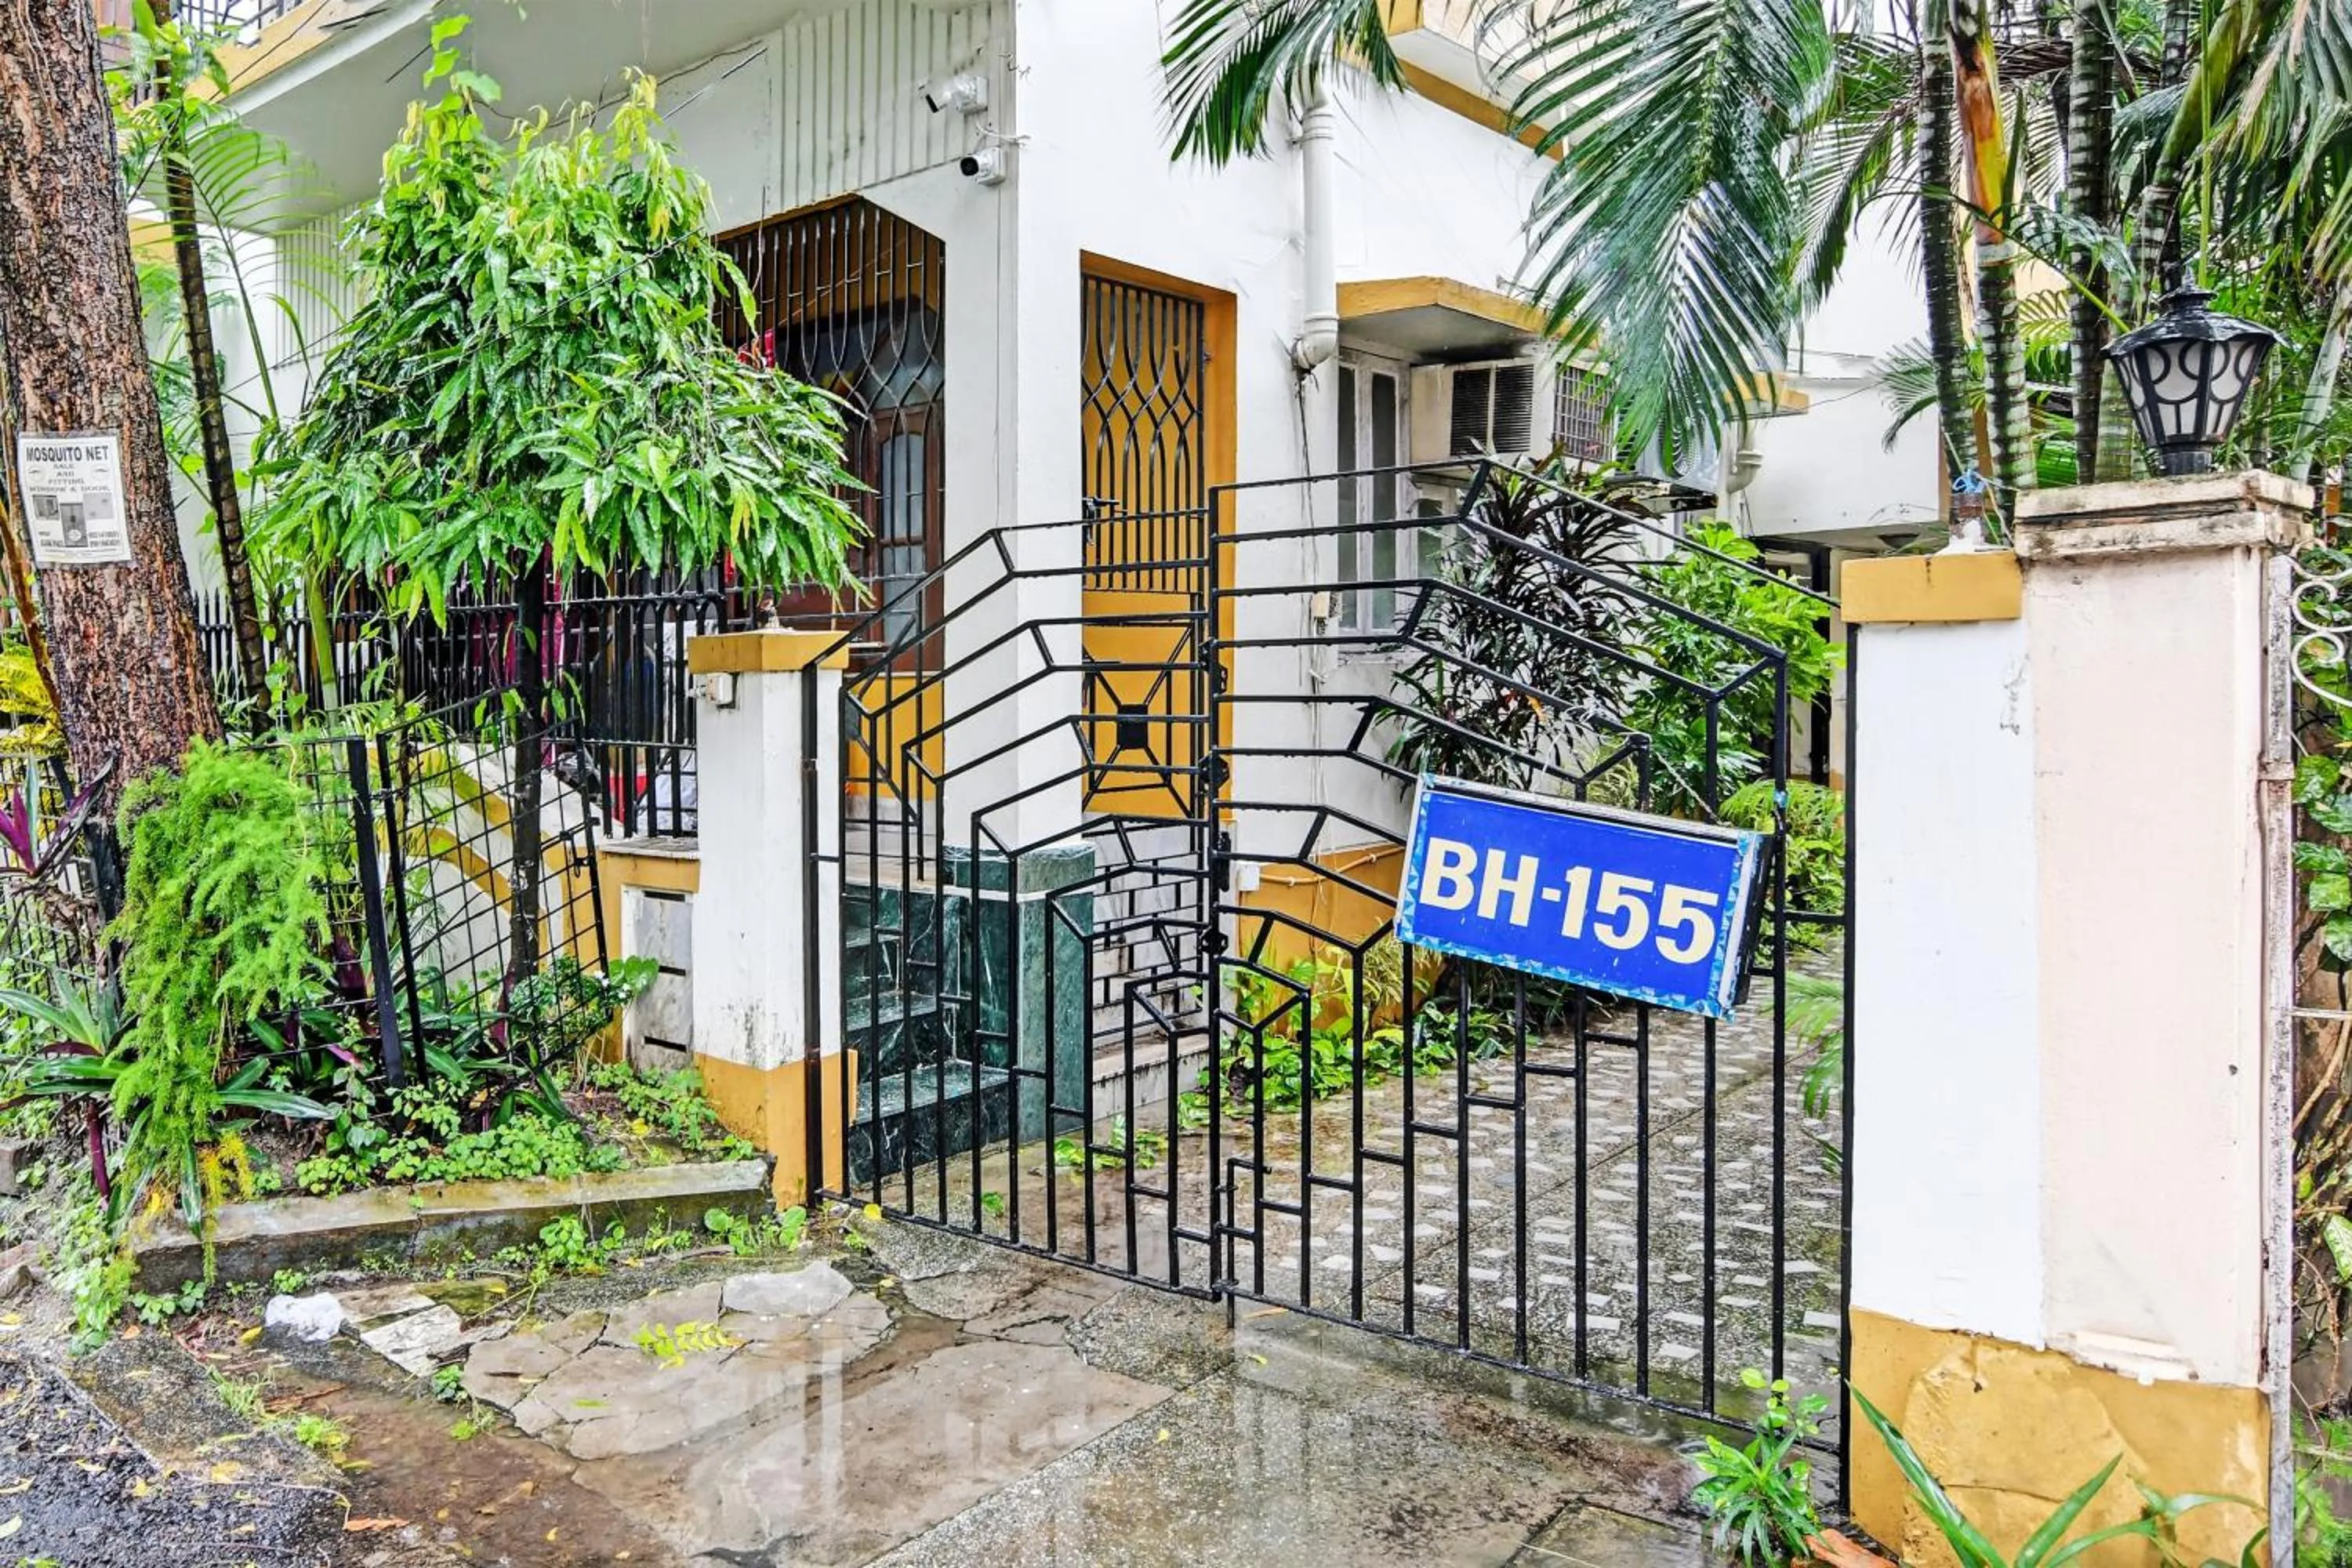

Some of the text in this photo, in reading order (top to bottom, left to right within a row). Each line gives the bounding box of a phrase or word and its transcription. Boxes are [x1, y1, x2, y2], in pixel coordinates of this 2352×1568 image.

[26, 445, 109, 462] MOSQUITO NET
[1418, 837, 1719, 964] BH-155
